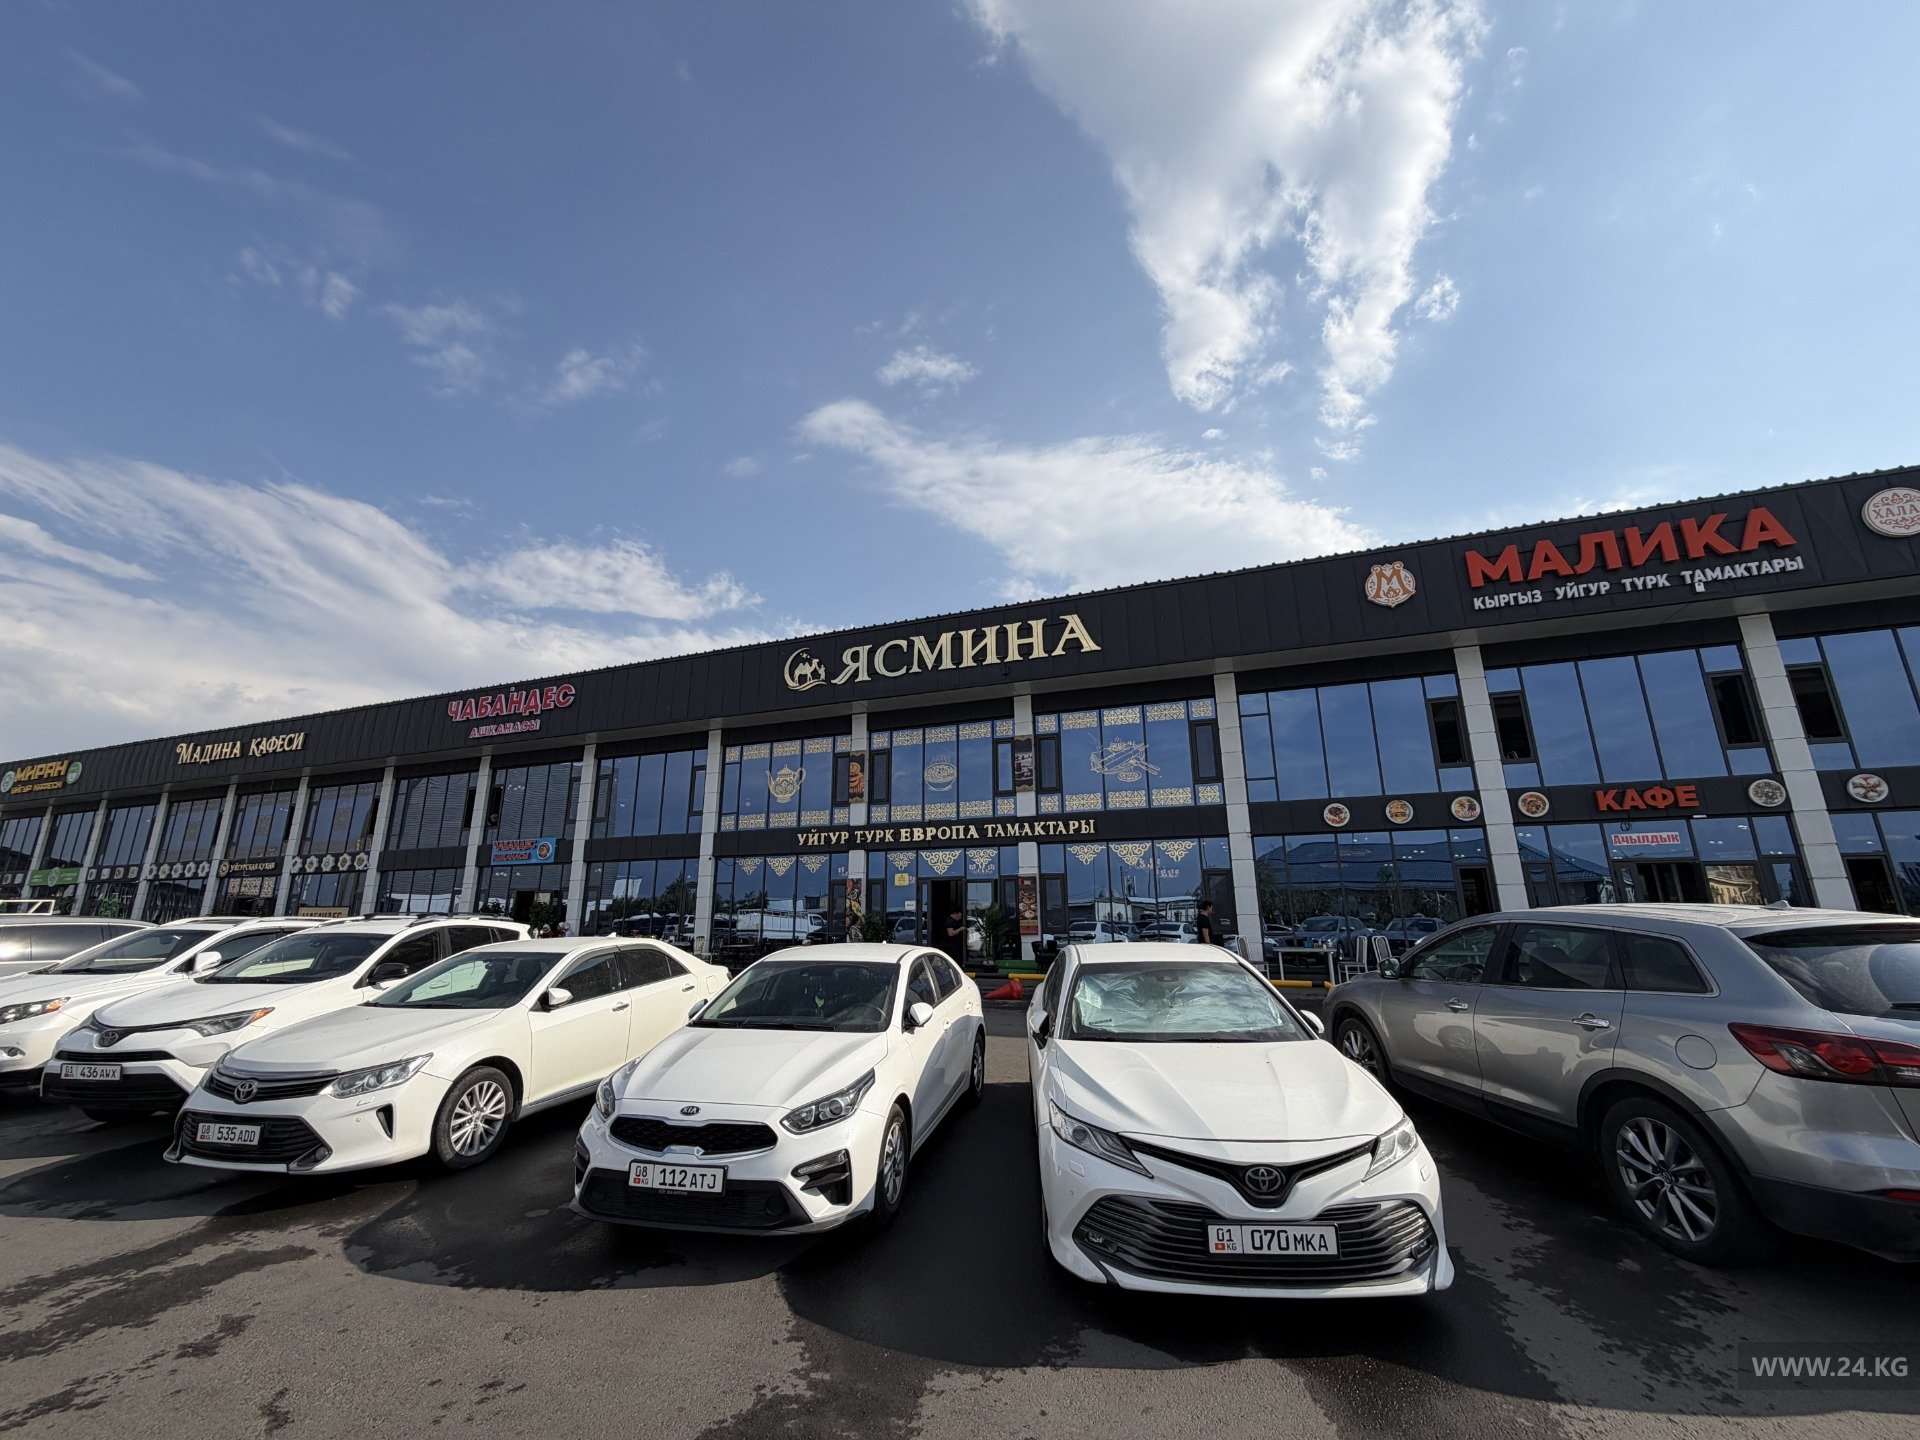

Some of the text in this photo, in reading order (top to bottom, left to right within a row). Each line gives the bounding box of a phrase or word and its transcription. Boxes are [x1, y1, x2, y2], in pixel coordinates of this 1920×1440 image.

[1465, 506, 1798, 590] МАЛИКА
[1473, 589, 1543, 611] КЫРГЫЗ
[1554, 581, 1611, 601] УЙГУР
[1680, 555, 1805, 586] ТАМАКТАРЫ
[830, 613, 1102, 686] ЯСМИНА
[447, 683, 576, 722] ЧАБАНДЕС
[468, 718, 541, 739] АШКАНАСЫ
[176, 732, 306, 765] МАДИНА КАФЕСИ
[13, 760, 69, 783] МИРАН
[1594, 785, 1700, 812] КАФЕ
[797, 818, 1096, 846] УЙГУР ТУРК ЕВРОПА ТАМАКТАРЫ
[682, 1106, 698, 1114] KIA
[1216, 1228, 1234, 1242] 01
[1226, 1242, 1237, 1251] KG
